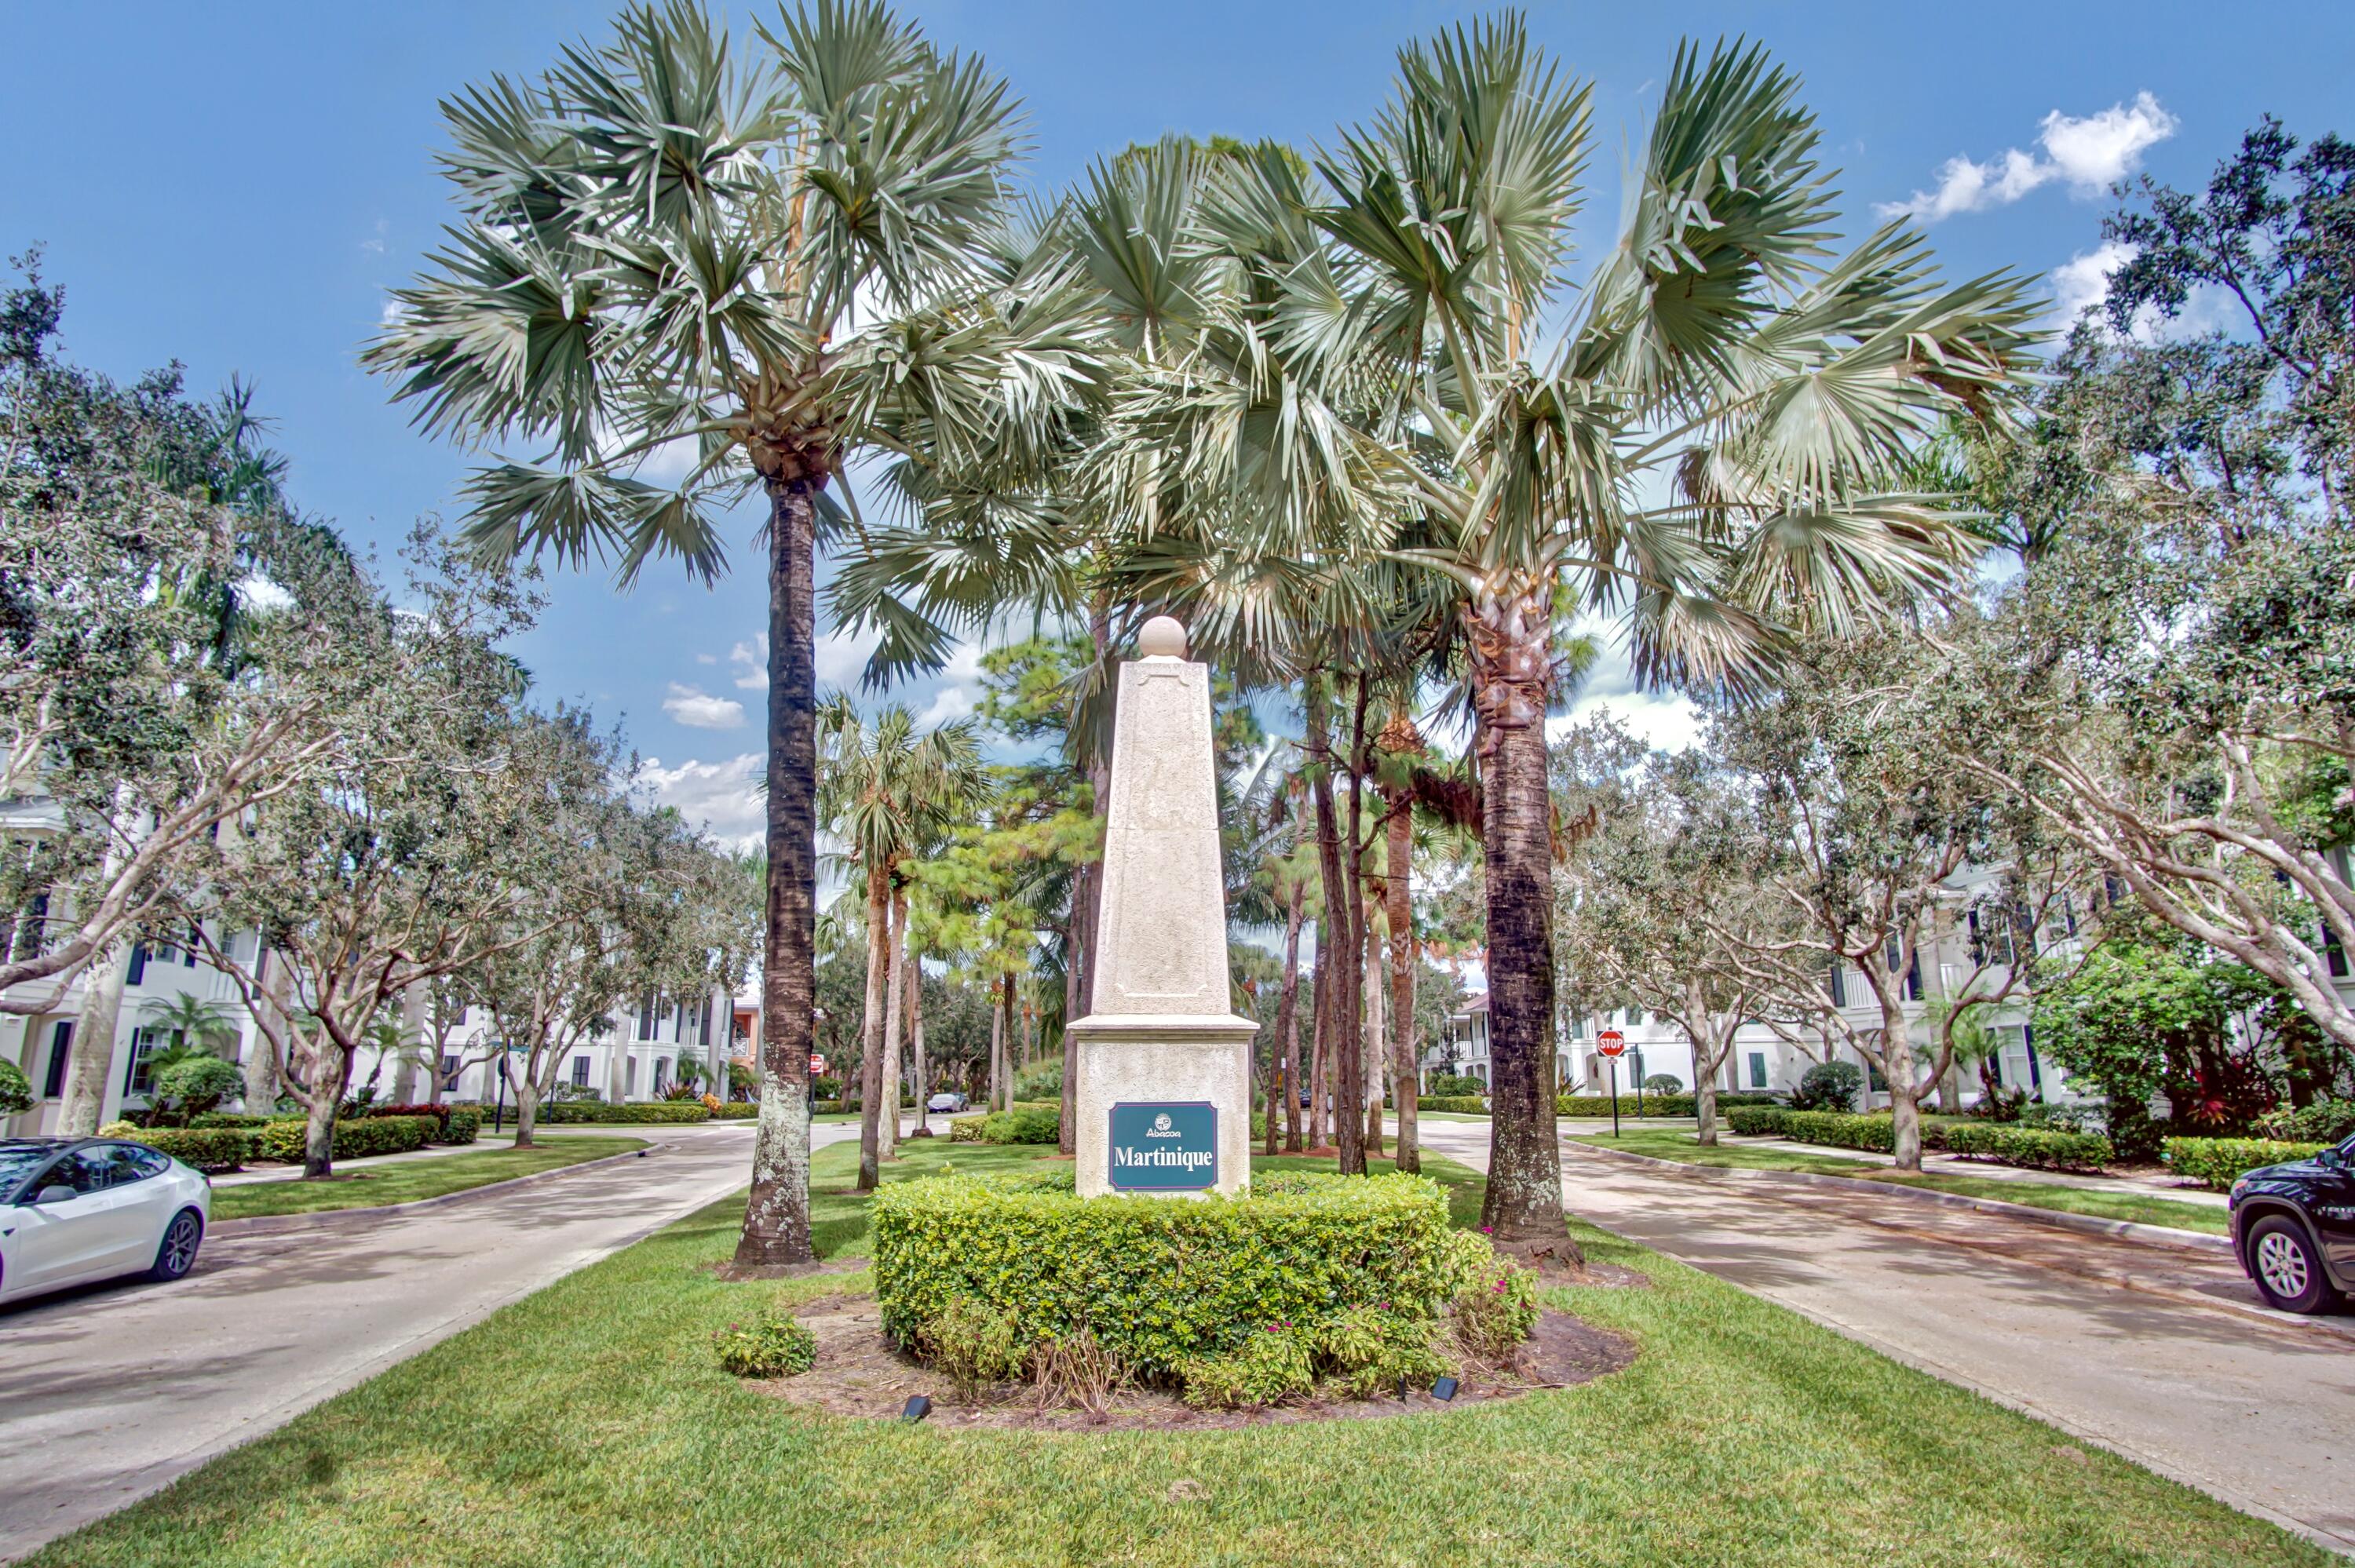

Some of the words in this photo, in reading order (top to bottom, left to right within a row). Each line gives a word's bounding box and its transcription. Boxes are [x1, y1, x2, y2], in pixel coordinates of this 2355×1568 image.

[1600, 1038, 1623, 1049] STOP
[1146, 1128, 1181, 1138] Abacoa
[1113, 1147, 1213, 1172] Martinique
